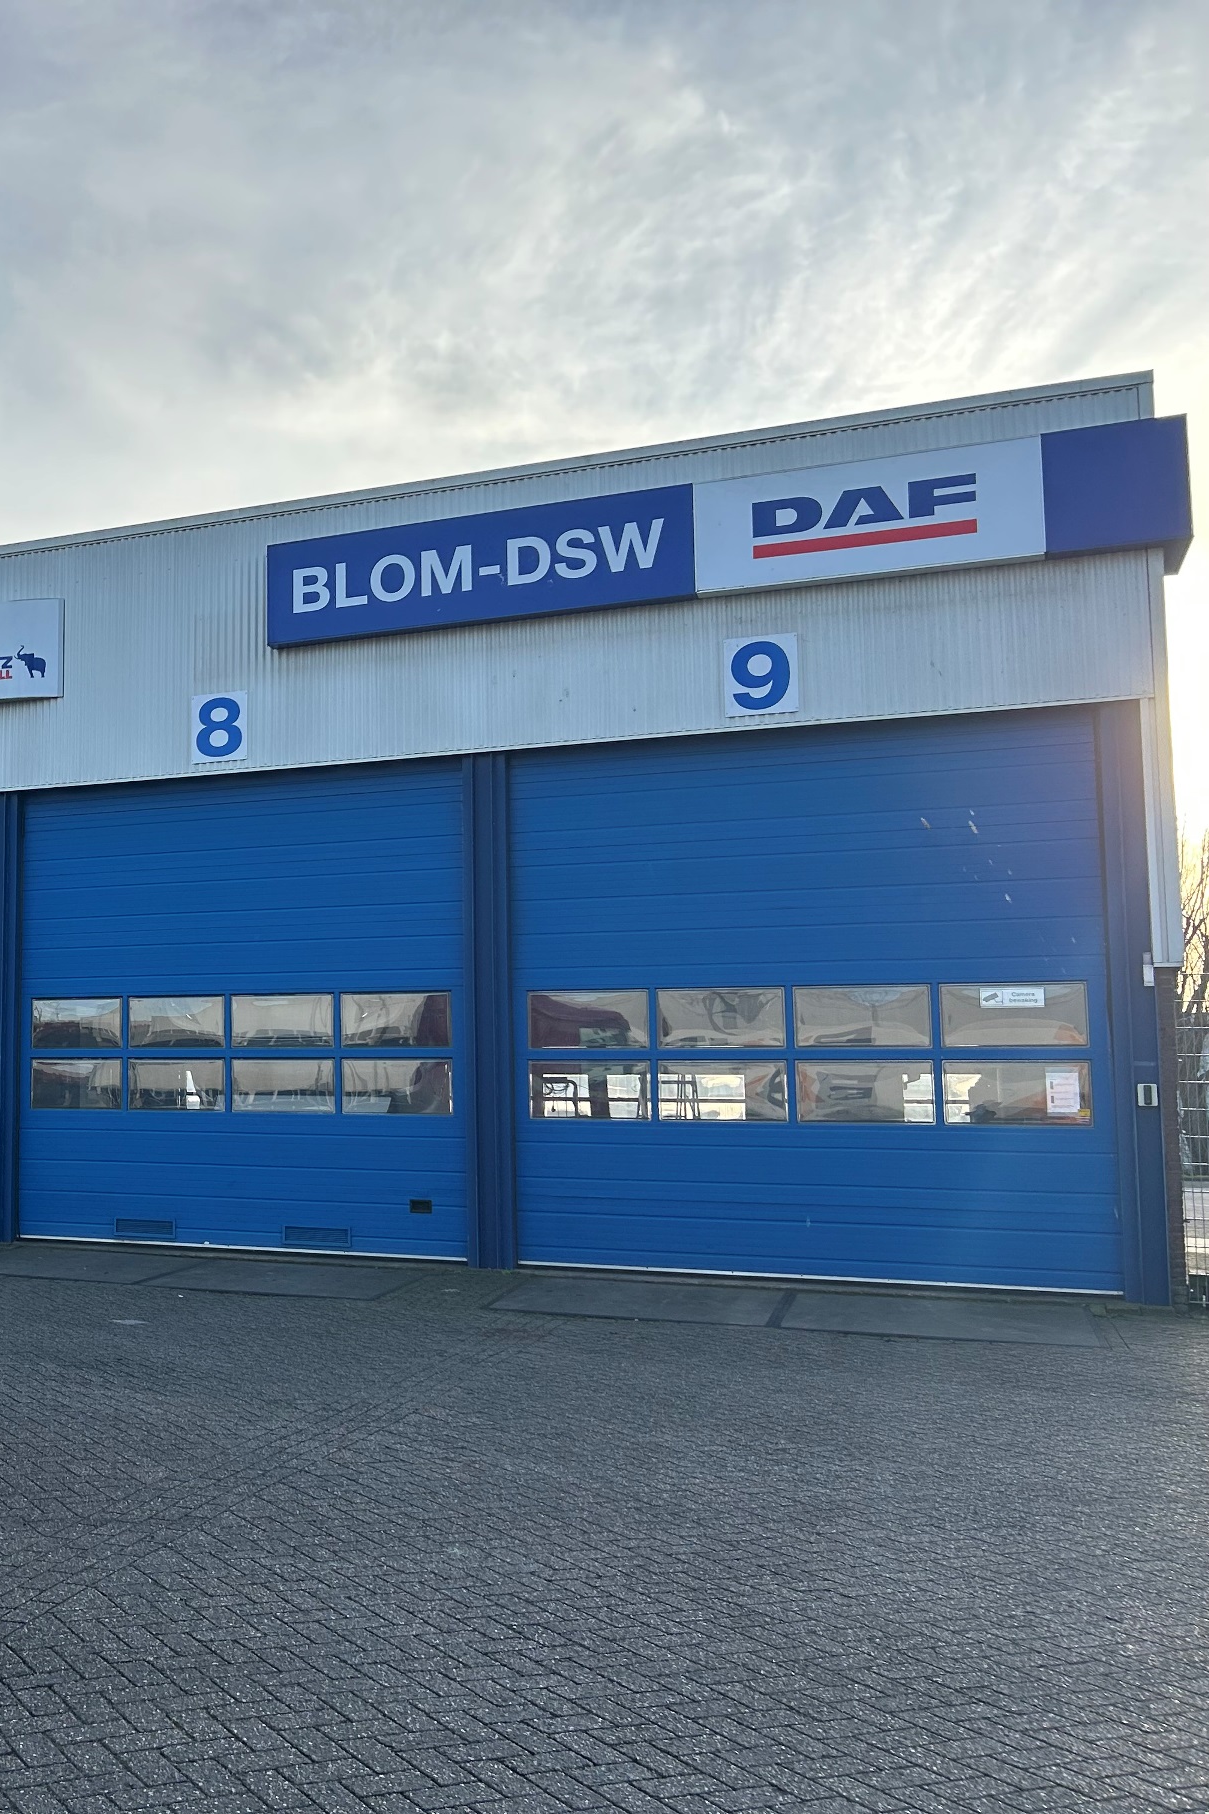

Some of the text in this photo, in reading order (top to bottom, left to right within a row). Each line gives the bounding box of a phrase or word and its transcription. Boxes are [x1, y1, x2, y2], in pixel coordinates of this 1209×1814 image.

[751, 472, 977, 539] DAF
[292, 518, 665, 614] BLOM-DSW
[730, 640, 791, 710] 9
[195, 697, 243, 758] 8
